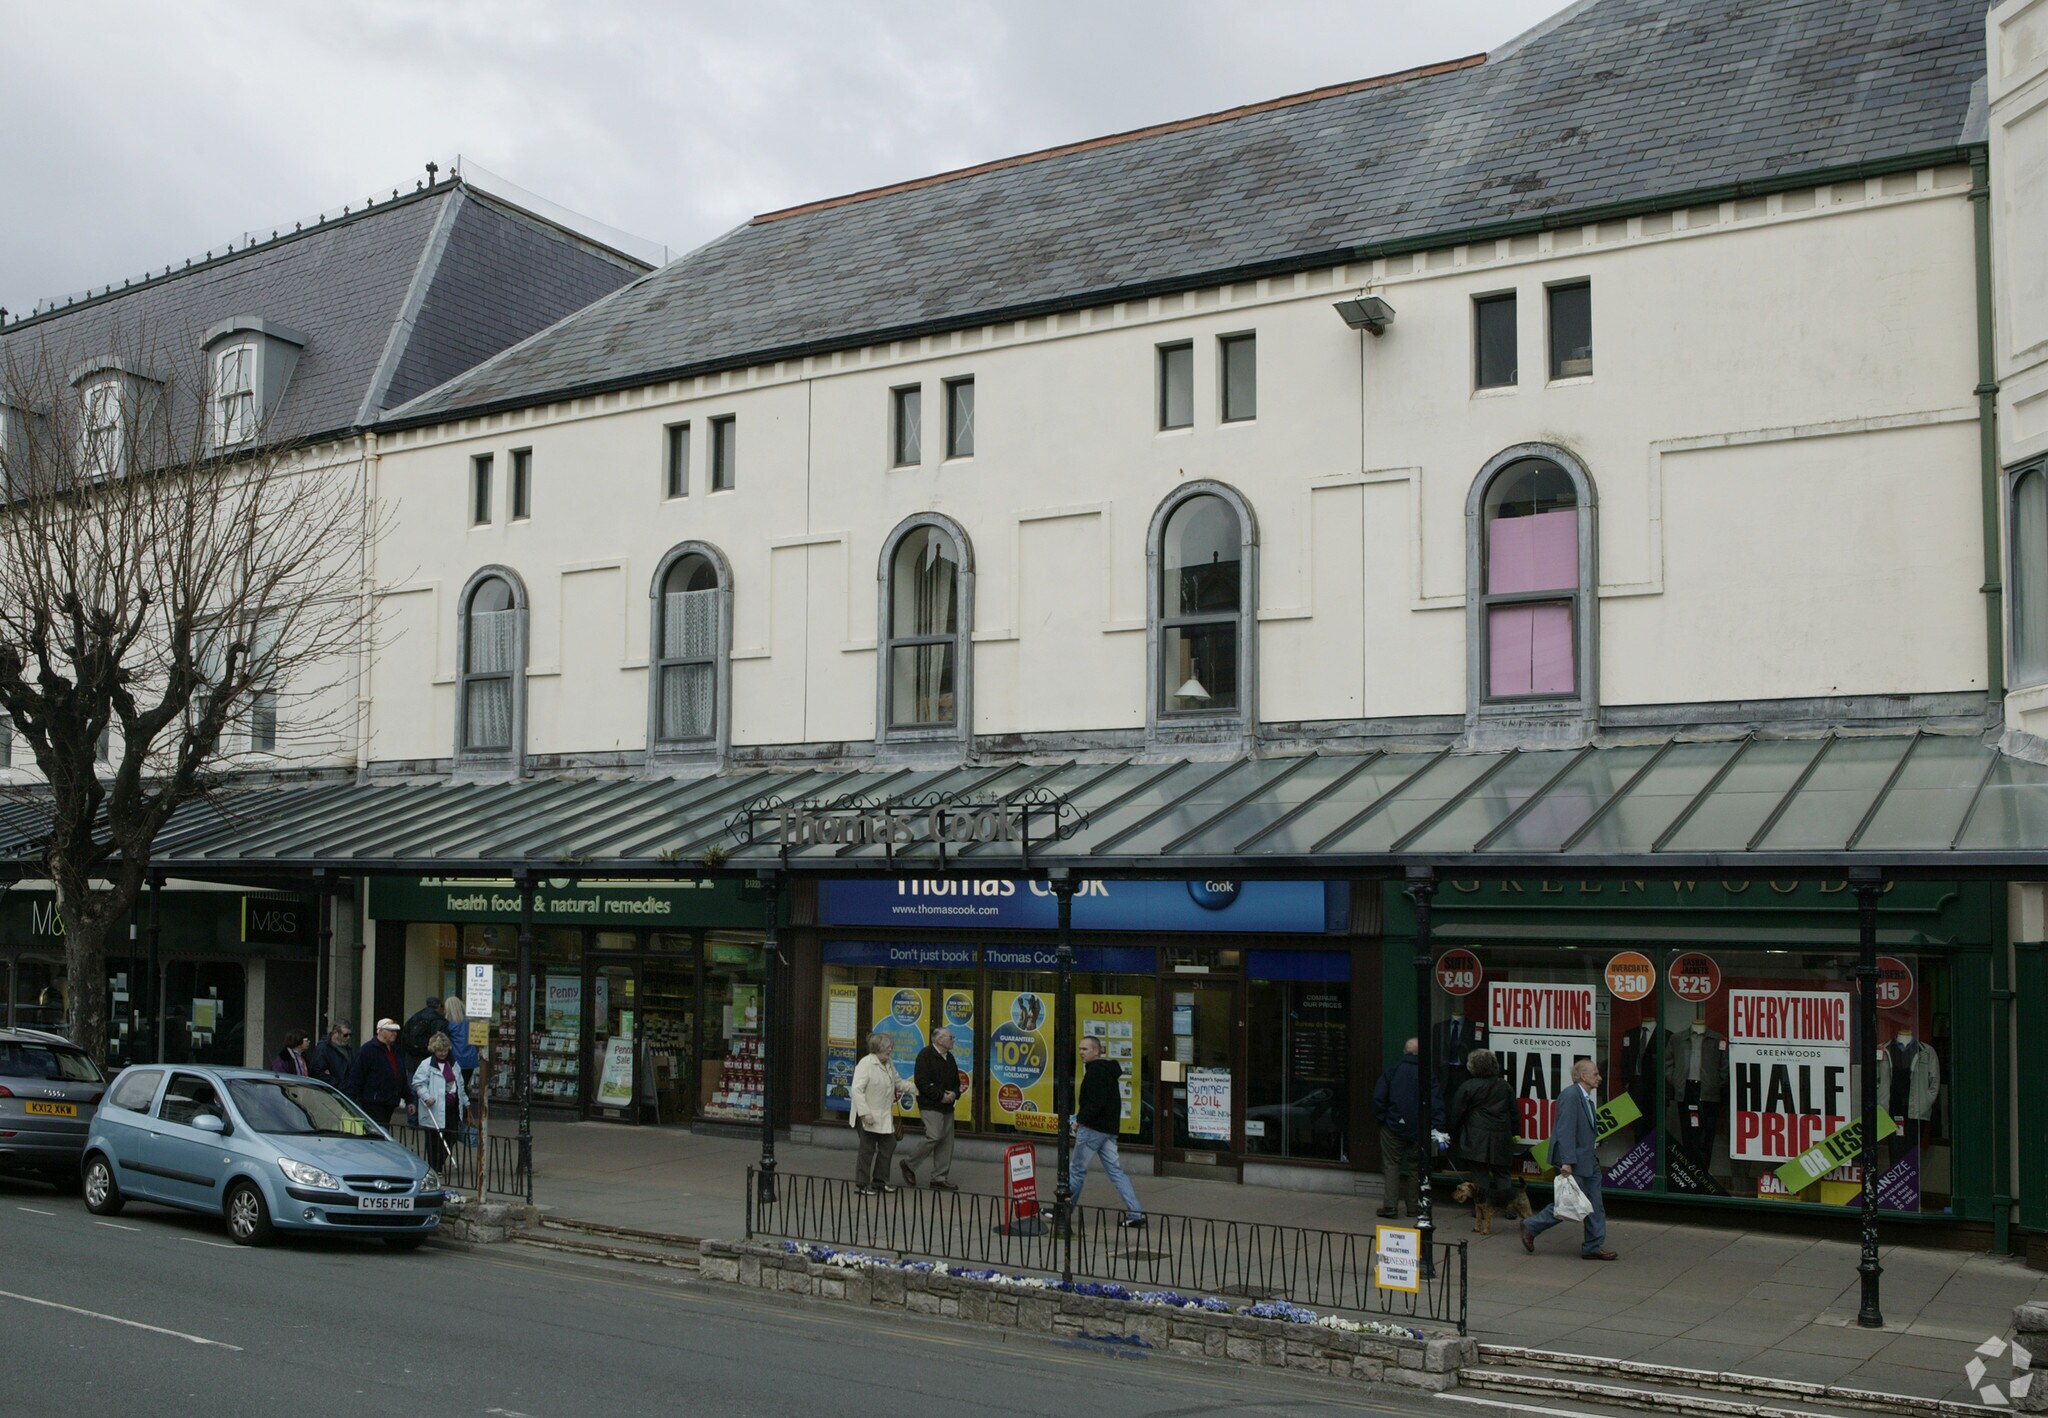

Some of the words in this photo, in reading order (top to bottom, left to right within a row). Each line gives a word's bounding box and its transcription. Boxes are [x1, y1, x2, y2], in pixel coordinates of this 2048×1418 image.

[772, 807, 914, 845] Thomas
[927, 802, 1022, 844] Cook
[1205, 880, 1234, 893] Cook
[447, 893, 488, 912] health
[533, 895, 546, 913] &
[550, 895, 600, 913] natural
[604, 896, 672, 914] remedies
[892, 904, 999, 916] www.thomascook.com
[252, 909, 297, 935] M&S
[890, 947, 918, 961] Don't
[919, 948, 940, 964] just
[941, 949, 969, 963] book
[1034, 951, 1059, 964] Coo
[1444, 957, 1474, 970] SUITS
[1444, 971, 1475, 988] £49
[1614, 974, 1648, 993] £50
[1678, 975, 1712, 994] £25
[549, 985, 580, 1001] Penny
[830, 989, 857, 998] FLIGHTS
[1306, 994, 1339, 1002] COMPARE
[1876, 982, 1901, 1001] 15
[1092, 1001, 1123, 1015] DEALS
[1302, 1001, 1318, 1009] OUR
[1318, 1001, 1343, 1010] PRICES
[1492, 987, 1592, 1031] EVERYTHING
[1733, 995, 1845, 1043] EVERYTHING
[1513, 1037, 1572, 1048] GREENWOODS
[616, 1055, 631, 1065] Sale
[994, 1041, 1041, 1068] 10%
[1756, 1048, 1822, 1059] GREENWOODS
[1003, 1071, 1030, 1080] HOLIDAYS
[1017, 1066, 1040, 1075] SUMMER
[1187, 1082, 1230, 1095] Summer
[1735, 1062, 1846, 1116] HALF
[32, 1103, 53, 1114] KX12
[1193, 1094, 1222, 1109] 2014
[1015, 1113, 1047, 1123] SUMMER
[1015, 1120, 1028, 1129] ON
[1028, 1121, 1046, 1130] SALE
[1046, 1122, 1059, 1131] NO
[1607, 1141, 1651, 1182] MANSIZE
[1799, 1147, 1832, 1179] OR
[1670, 1172, 1687, 1188] now
[1671, 1161, 1697, 1189] in-store
[1876, 1160, 1912, 1194] ANSIZE
[1760, 1174, 1789, 1194] SAL
[362, 1197, 389, 1209] CY56
[390, 1198, 410, 1209] FHG
